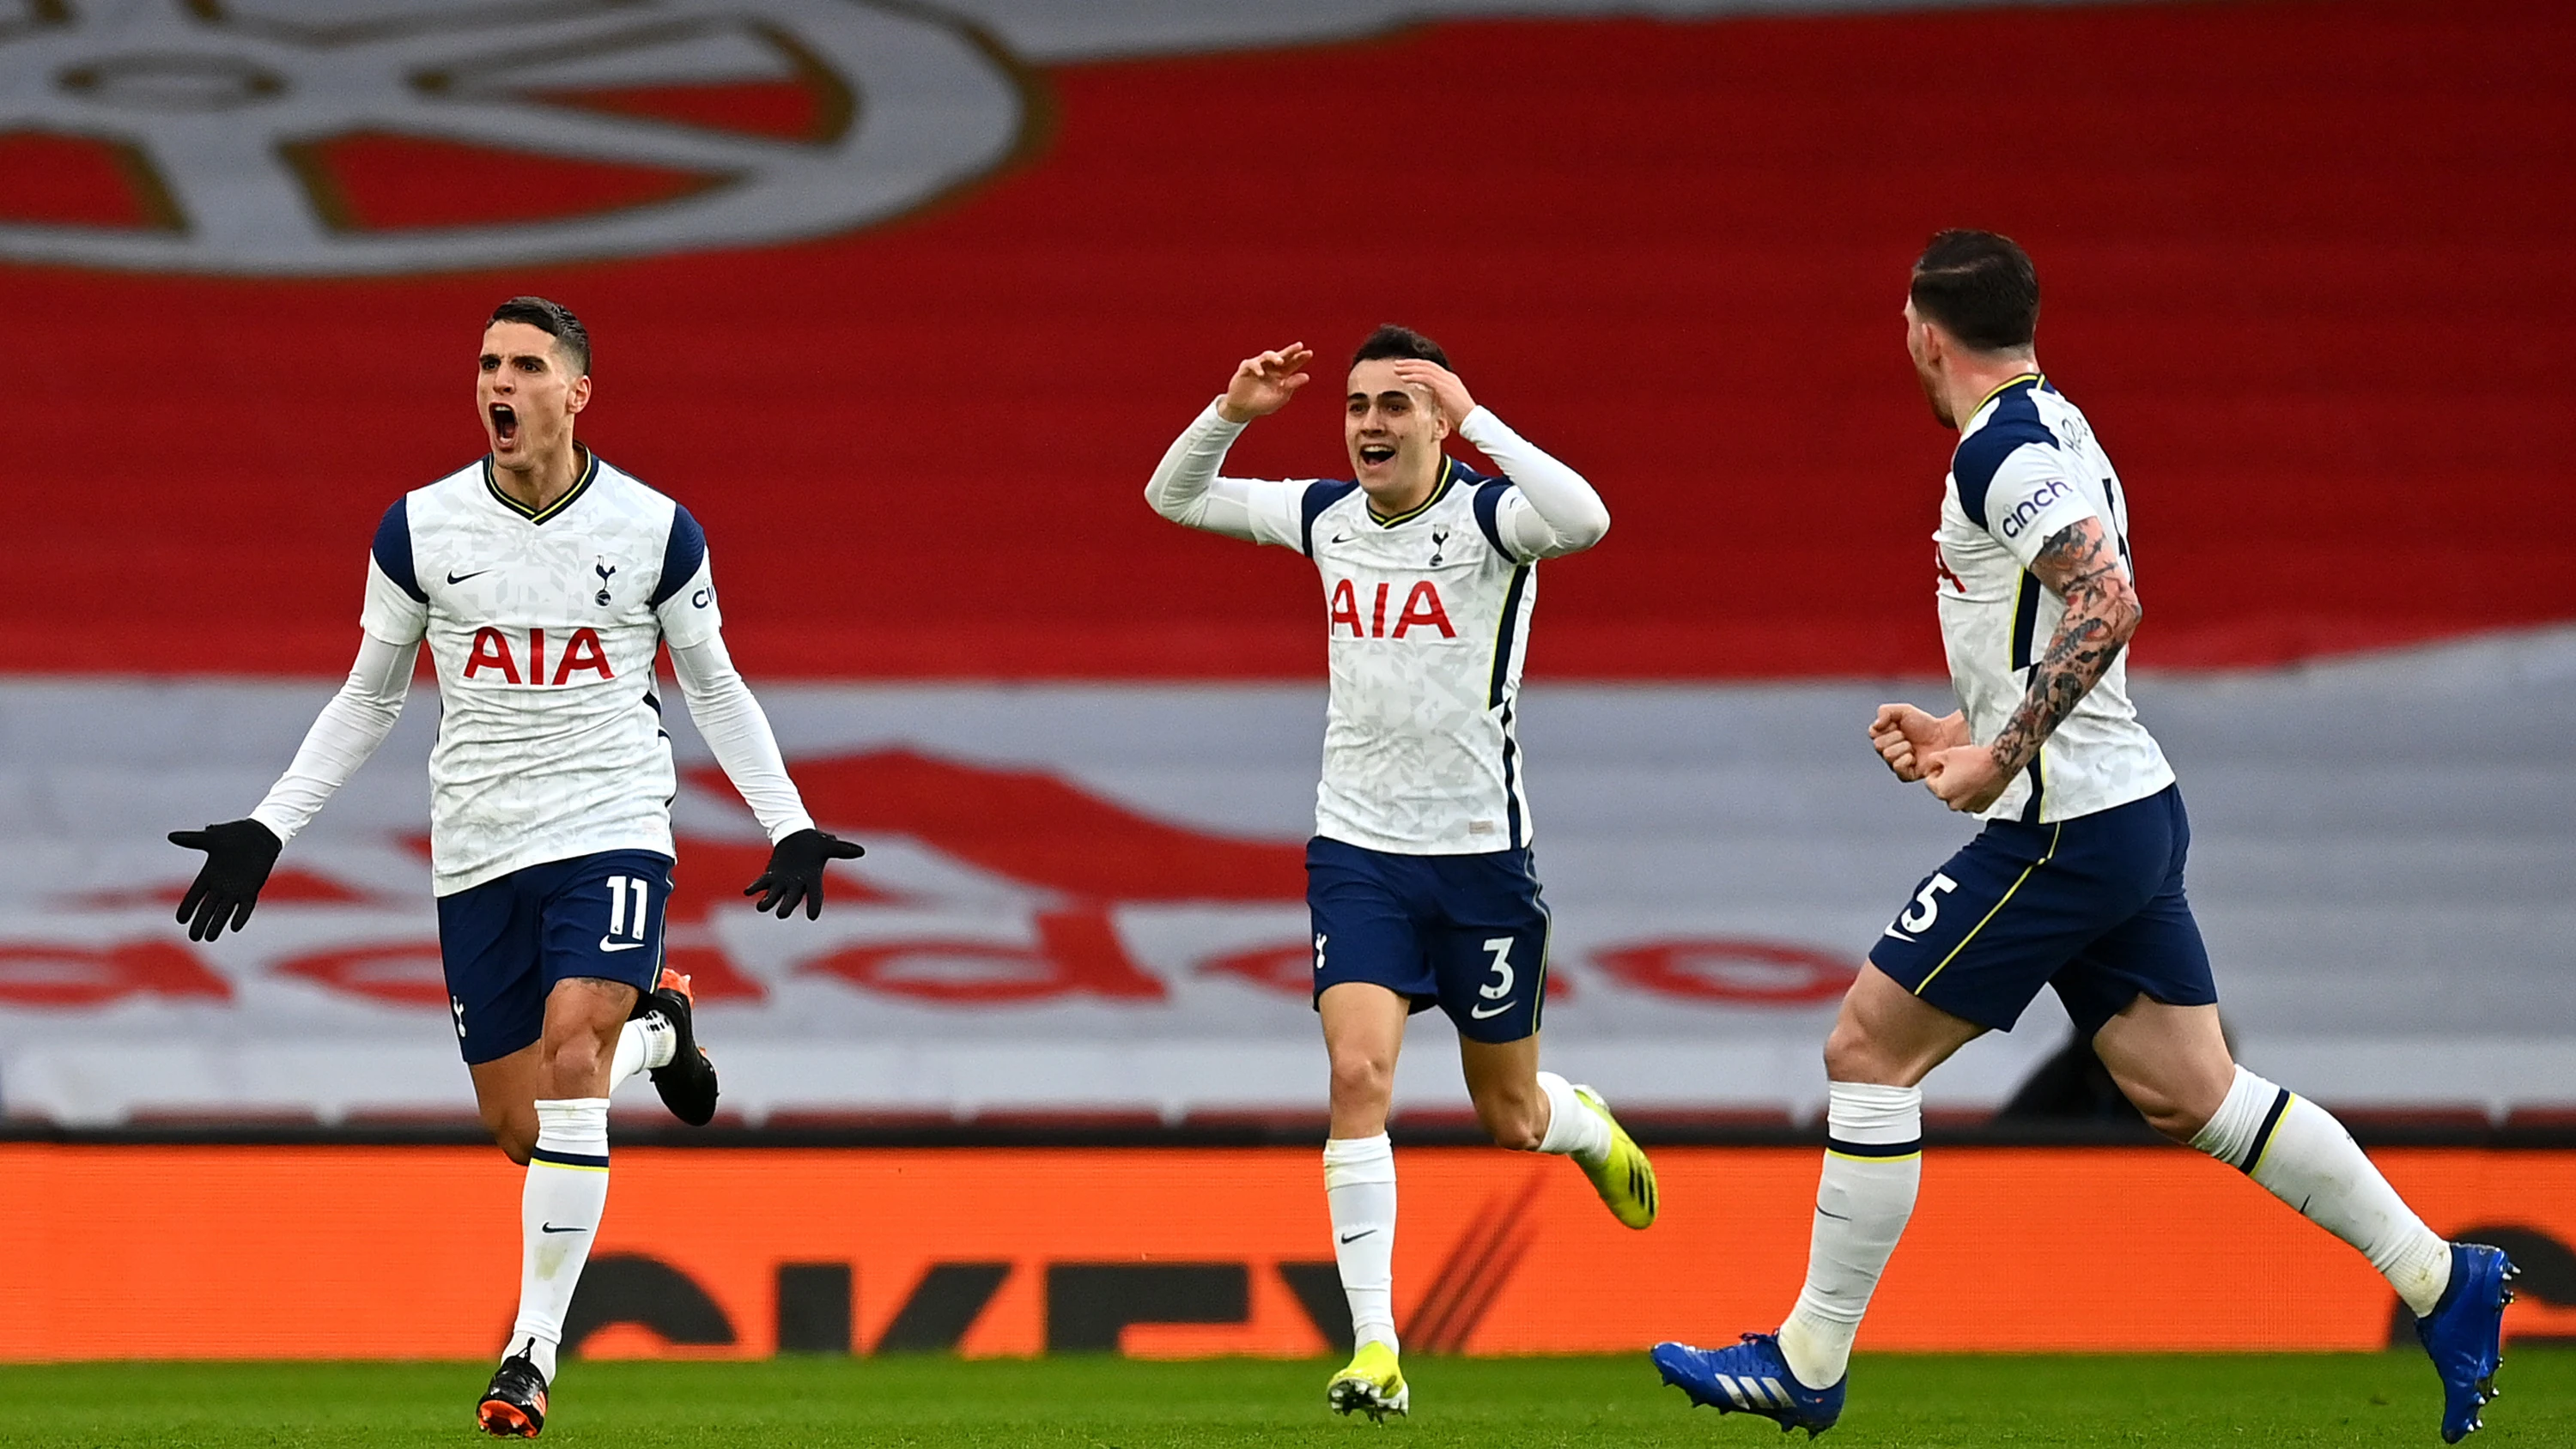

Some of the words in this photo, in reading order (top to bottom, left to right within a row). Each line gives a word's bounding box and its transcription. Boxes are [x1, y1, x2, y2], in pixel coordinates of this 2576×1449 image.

[2002, 480, 2073, 539] cinch
[1331, 579, 1457, 639] AIA
[463, 626, 616, 686] AIA
[605, 875, 648, 941] 11
[1900, 872, 1958, 934] 5
[1479, 936, 1515, 1001] 3
